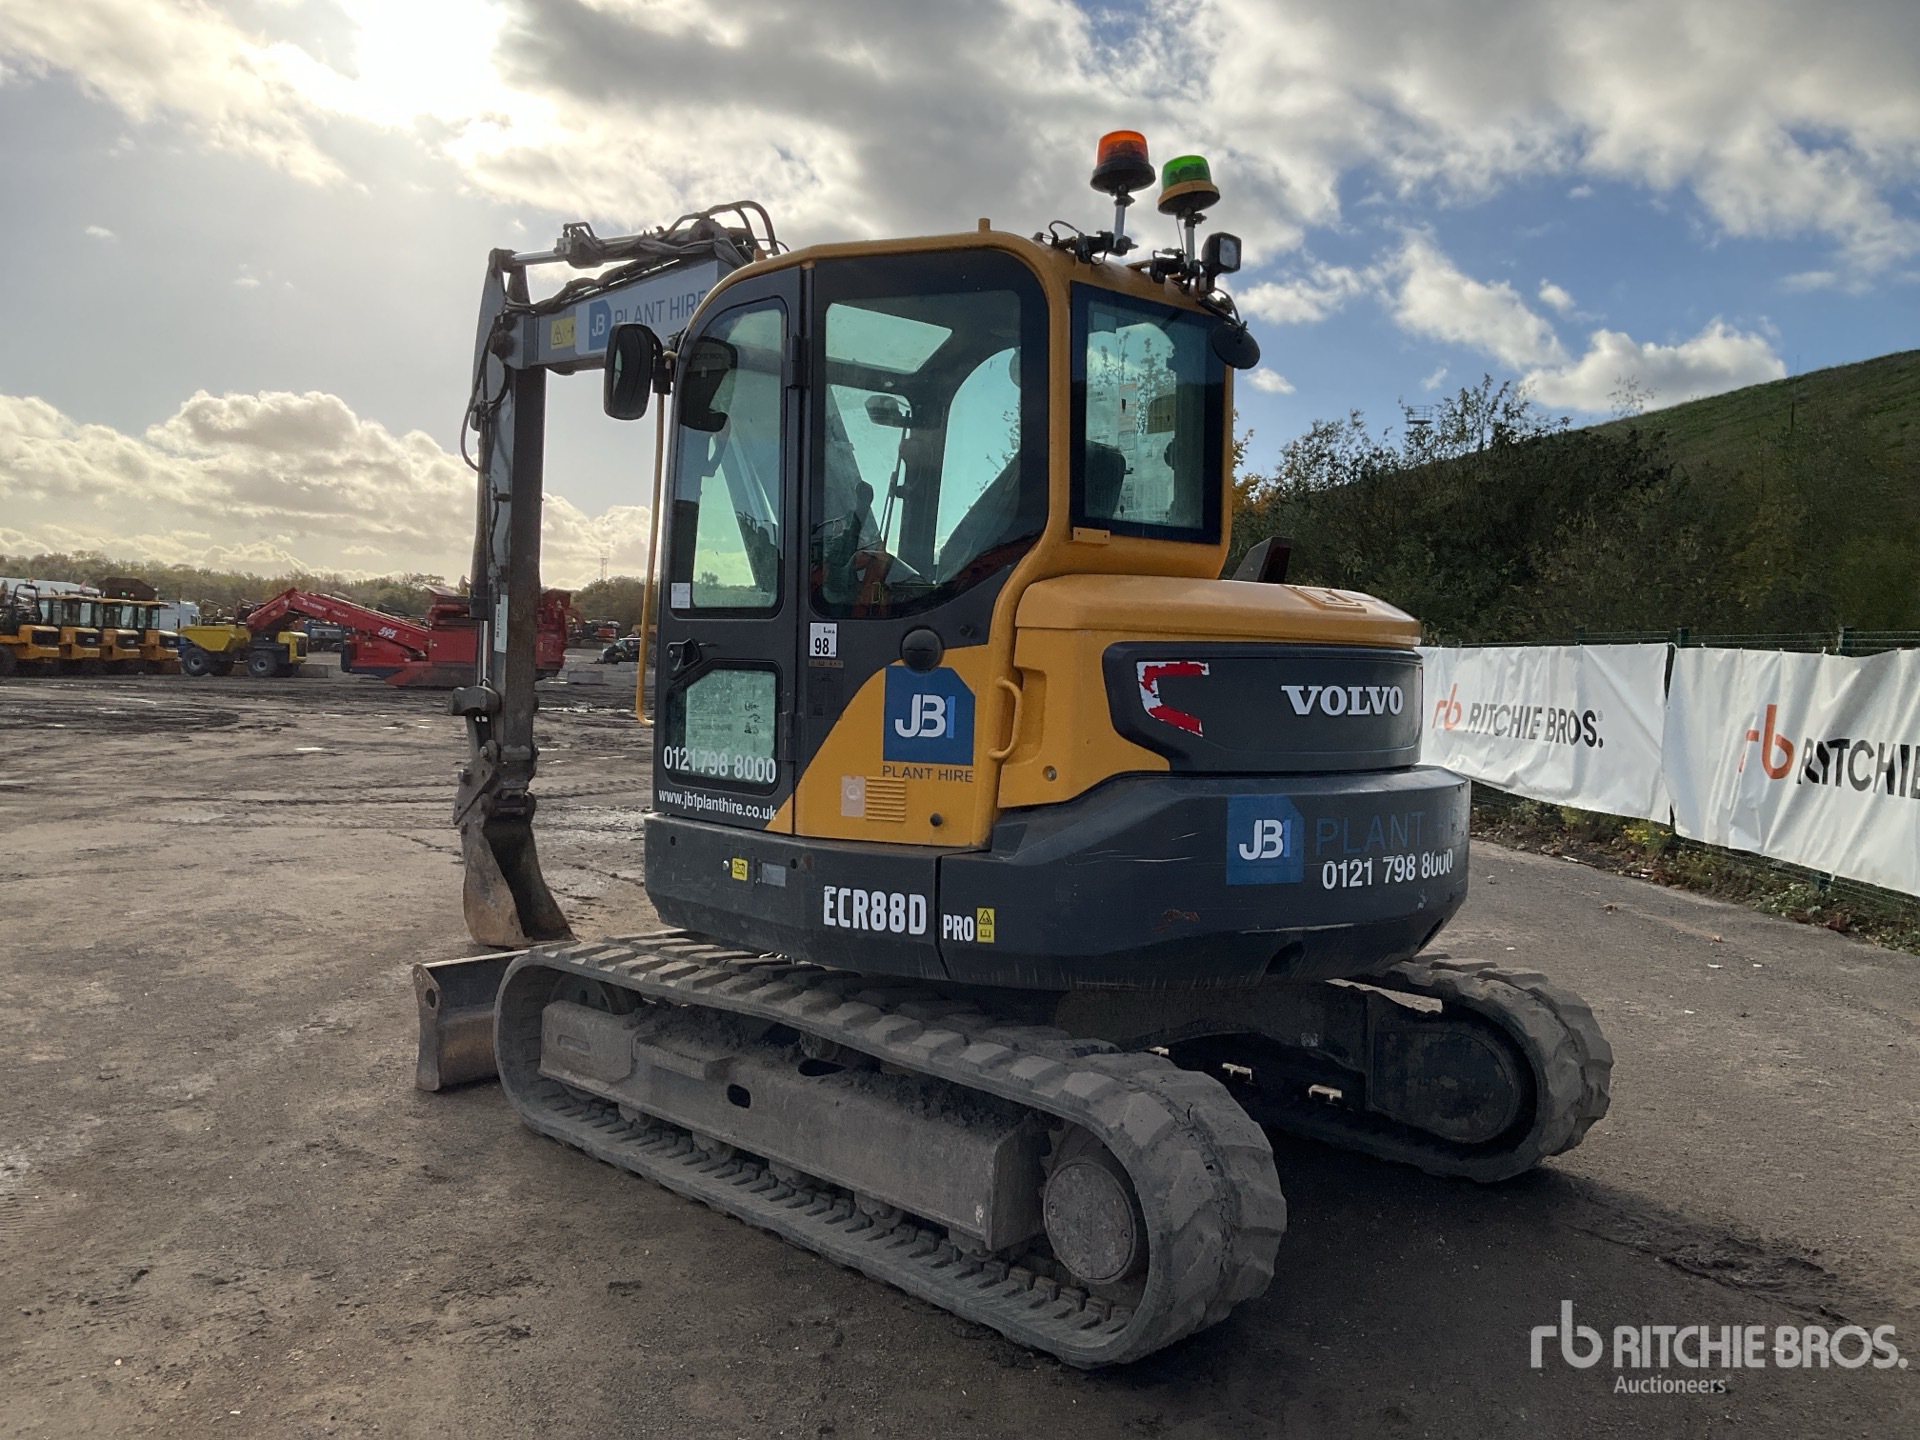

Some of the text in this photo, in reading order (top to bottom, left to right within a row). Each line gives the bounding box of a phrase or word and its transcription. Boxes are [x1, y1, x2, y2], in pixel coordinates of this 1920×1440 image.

[378, 626, 398, 639] 595
[814, 637, 830, 655] 98
[894, 694, 956, 739] JB1
[1281, 685, 1404, 717] VOLVO
[1465, 702, 1542, 740] RITCHIE
[663, 745, 776, 783] 0121 798 8000
[882, 765, 974, 783] PLANT HIRE
[658, 789, 777, 820] www.jb1planthire.co.uk
[1238, 818, 1292, 860] JB1
[1316, 811, 1426, 857] PLANT
[1322, 858, 1373, 889] 0121
[1383, 854, 1416, 884] 798
[823, 885, 927, 935] ECR88D
[943, 914, 974, 942] PRO
